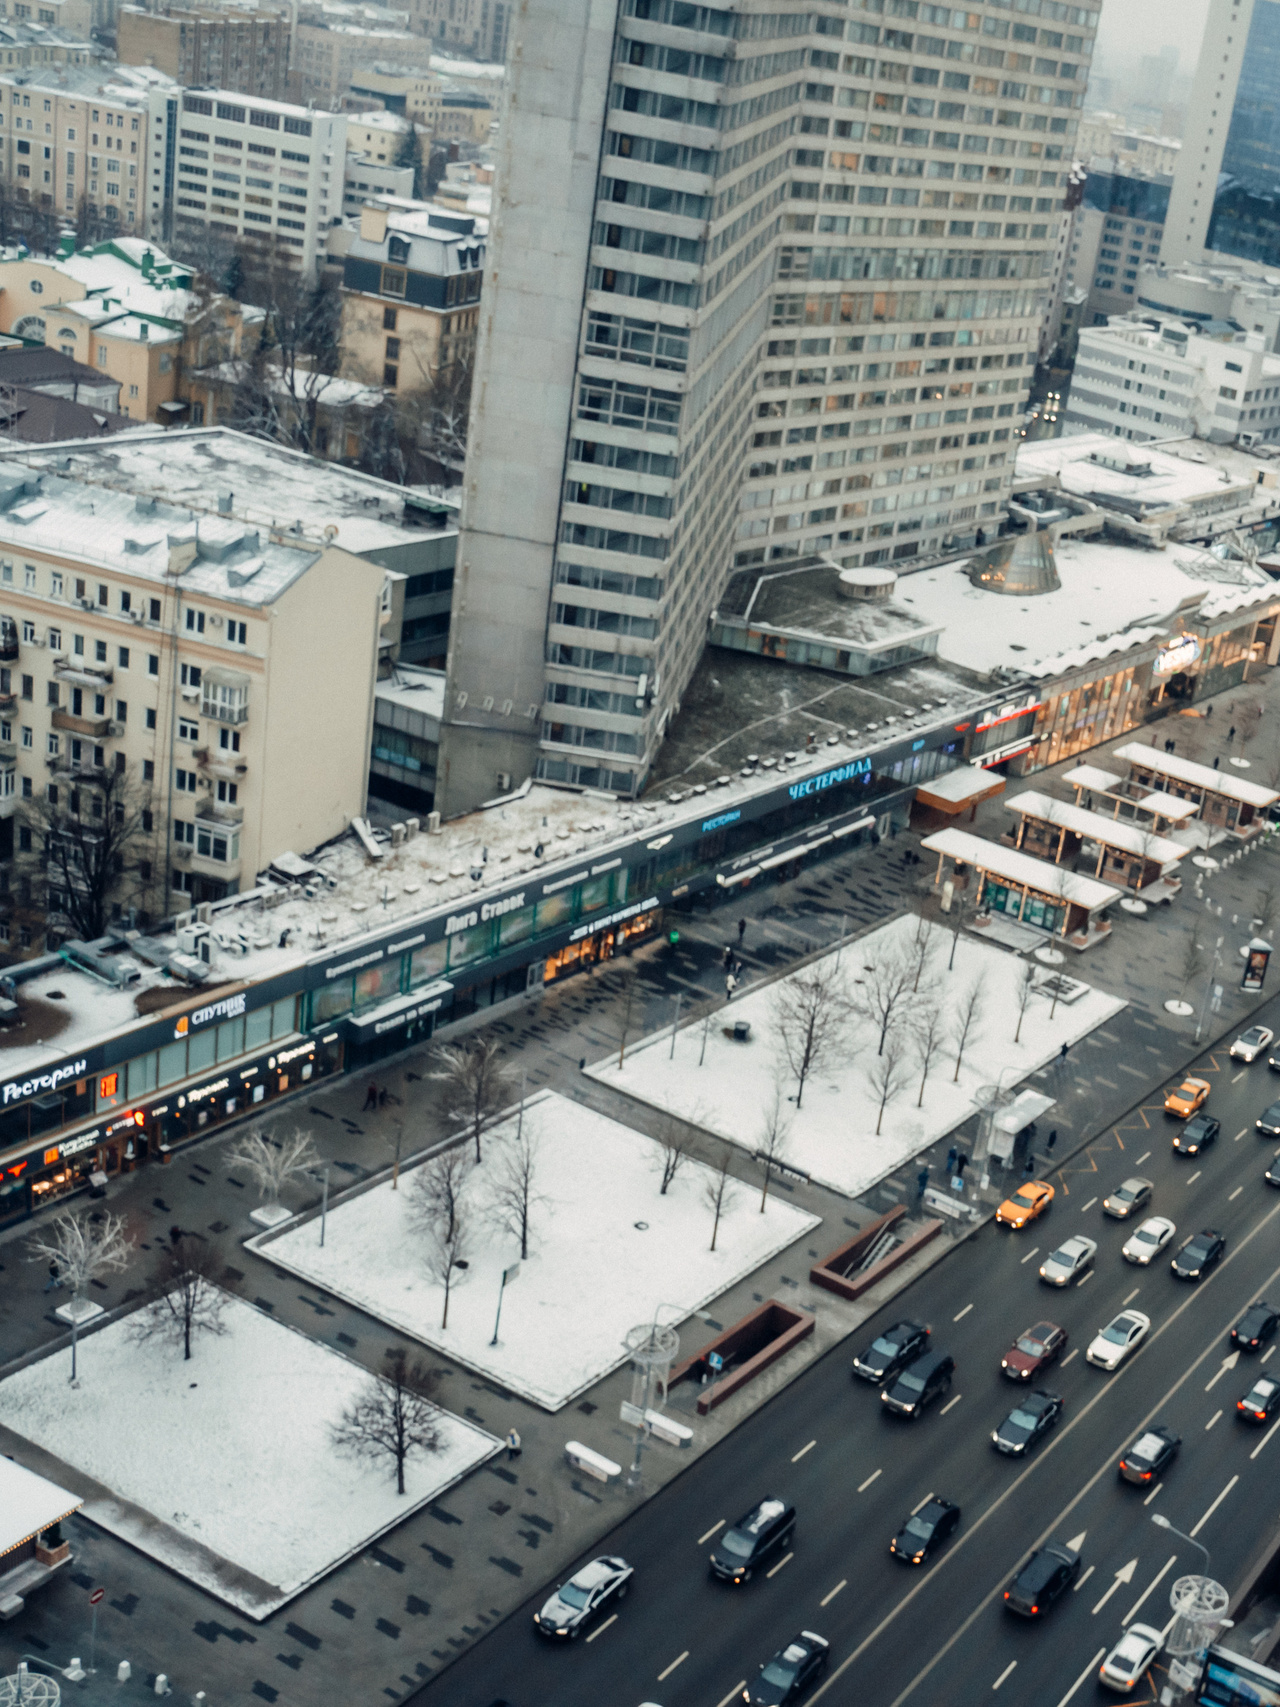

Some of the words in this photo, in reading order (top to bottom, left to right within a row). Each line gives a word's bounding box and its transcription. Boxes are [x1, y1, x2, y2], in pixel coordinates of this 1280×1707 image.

[788, 757, 872, 800] ЧЕСТЕРФИЛД
[444, 910, 478, 936] Лига
[480, 892, 526, 921] Ставок
[2, 1059, 87, 1104] Ресторан
